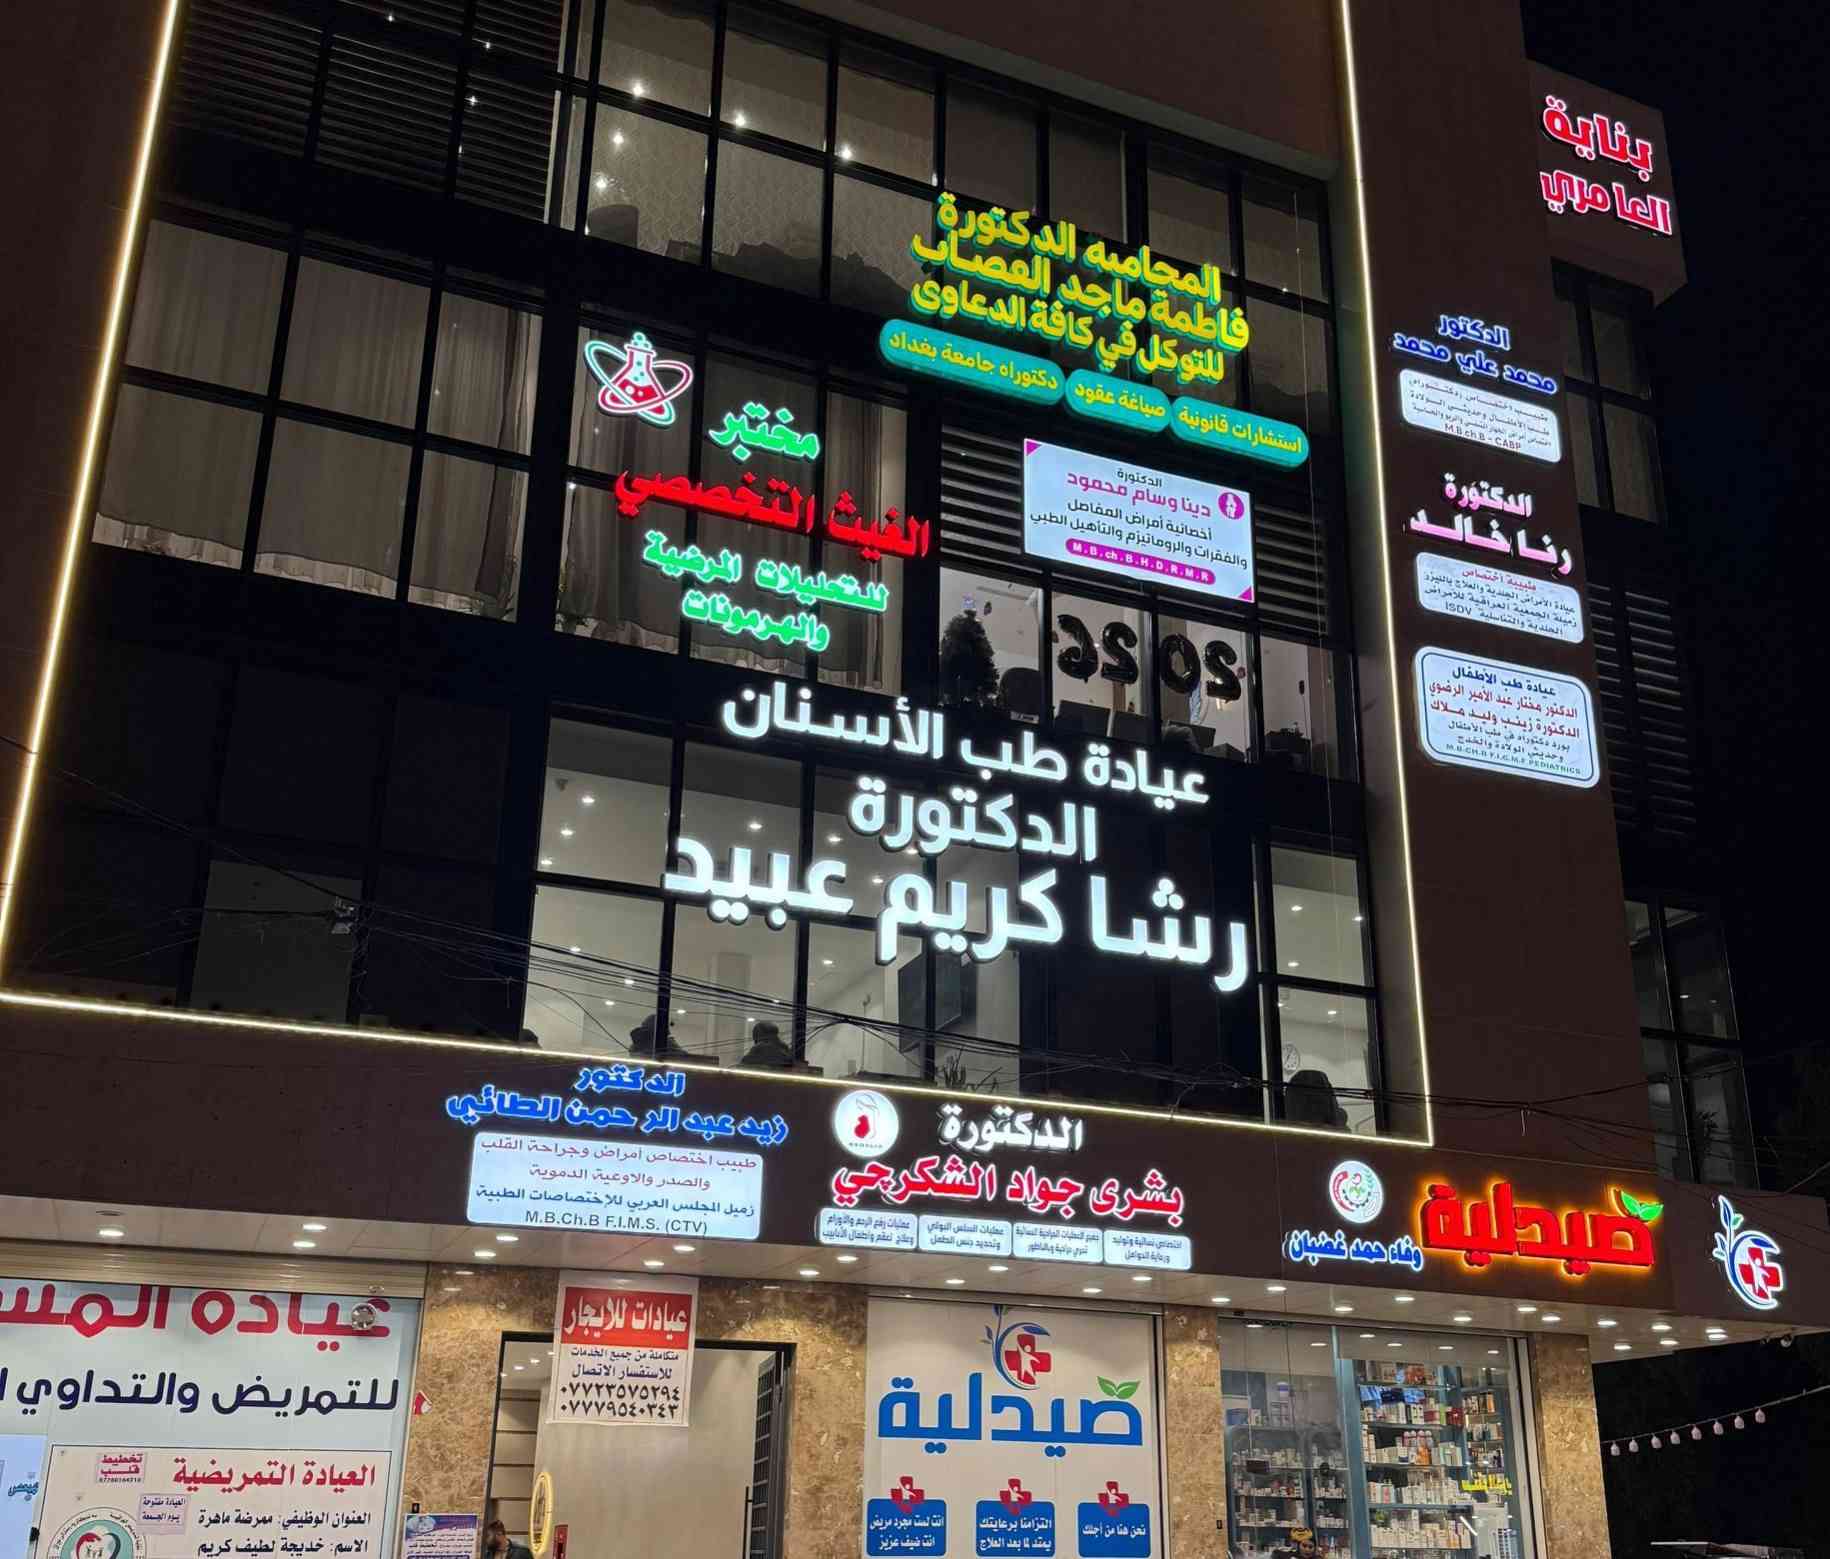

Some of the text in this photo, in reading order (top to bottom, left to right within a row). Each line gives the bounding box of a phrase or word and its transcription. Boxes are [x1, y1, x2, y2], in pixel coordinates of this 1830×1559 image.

[1543, 95, 1653, 182] بناية
[1539, 170, 1672, 235] العامري
[937, 192, 1076, 263] الدكتورة
[1057, 274, 1147, 323] ماجد
[1149, 289, 1250, 351] فاطمة
[911, 280, 1225, 384] للتوكل في كافة الدعاوى
[1438, 314, 1511, 350] الدكتور
[889, 330, 1058, 389] دكتوراه جامعة بغداد
[1393, 332, 1558, 395] محمد علي محمد
[1074, 383, 1166, 418] صياغة عقود
[708, 401, 820, 462] مختبر
[1178, 406, 1302, 453] استشارات قانونية
[1117, 467, 1162, 488] الدكتورة
[1067, 472, 1211, 519] دينا وسام محمود
[1443, 472, 1532, 517] الدكتورة
[614, 470, 931, 562] الغيث التخصصي
[1067, 499, 1122, 520] المفاصل
[1125, 511, 1163, 529] أمراض
[1030, 511, 1248, 570] والفقرات والروماتيزم والتأهيل الطبي
[1516, 528, 1572, 575] رنا
[643, 530, 889, 612] للتحليلات المرضية
[1462, 568, 1504, 583] اختصاص
[682, 590, 830, 651] والهرمونات
[1501, 677, 1556, 699] عيادة طب
[1430, 699, 1465, 717] ملاك
[1496, 695, 1513, 710] عبد
[1516, 696, 1542, 712] مختار
[1544, 702, 1578, 718] الدكتور
[1468, 707, 1498, 725] وليد
[1500, 716, 1533, 733] زينب
[1536, 717, 1580, 738] الدكتورة
[722, 680, 1210, 811] عيادة طب الأسنان
[847, 775, 1098, 864] الدكتورة
[662, 836, 1249, 993] رشا كريم عبيد
[575, 1064, 686, 1096] الدكتور
[446, 1084, 563, 1125] الطائي
[682, 1111, 736, 1141] عبد
[737, 1113, 790, 1144] زيد
[940, 1103, 1084, 1151] الدكتورة
[481, 1137, 522, 1153] القلب
[527, 1140, 589, 1158] وجراحة
[646, 1151, 712, 1166] اختصاص
[716, 1157, 757, 1173] طبيب
[529, 1164, 588, 1181] الدموية
[476, 1185, 525, 1202] الطبية
[656, 1176, 711, 1191] والصدر
[1006, 1166, 1085, 1220] جواد
[627, 1198, 669, 1212] العربي
[672, 1199, 720, 1216] المجلس
[1090, 1168, 1184, 1227] بشرى
[723, 1203, 755, 1217] زميل
[525, 1210, 708, 1235] M.B.Ch.B F.I.M.S. (CTV)
[1420, 1181, 1655, 1276] صيدلية
[1288, 1229, 1424, 1272] وفاء حمد غضبان
[564, 1296, 687, 1340] عيادات للايجار
[570, 1347, 679, 1361] متكاملة من جميع الخدمات
[571, 1363, 673, 1380] للاستفسار الاتصال
[17, 1369, 200, 1416] والتداوي
[212, 1375, 400, 1418] للتمريض
[878, 1372, 1143, 1458] صيدلية
[101, 1453, 144, 1466] تخطيط
[101, 1464, 140, 1477] قلب
[172, 1457, 376, 1494] العيادة التمريضية
[198, 1508, 231, 1529] ماهرة
[234, 1508, 273, 1529] ممرضة
[332, 1509, 371, 1528] العنوان
[869, 1514, 892, 1530] مريض
[893, 1517, 912, 1530] مجرد
[913, 1514, 930, 1527] لست
[979, 1516, 1052, 1532] التزامنا برعايتك
[1116, 1523, 1129, 1535] هنا
[1104, 1524, 1115, 1538] من
[1130, 1523, 1146, 1539] نحن
[198, 1538, 233, 1558] كريم
[235, 1538, 276, 1557] لطيف
[280, 1537, 324, 1557] خديجة
[878, 1534, 899, 1550] عزيز
[900, 1534, 921, 1550] ضيف
[979, 1536, 1005, 1551] العلاج
[1006, 1537, 1022, 1551] بعد
